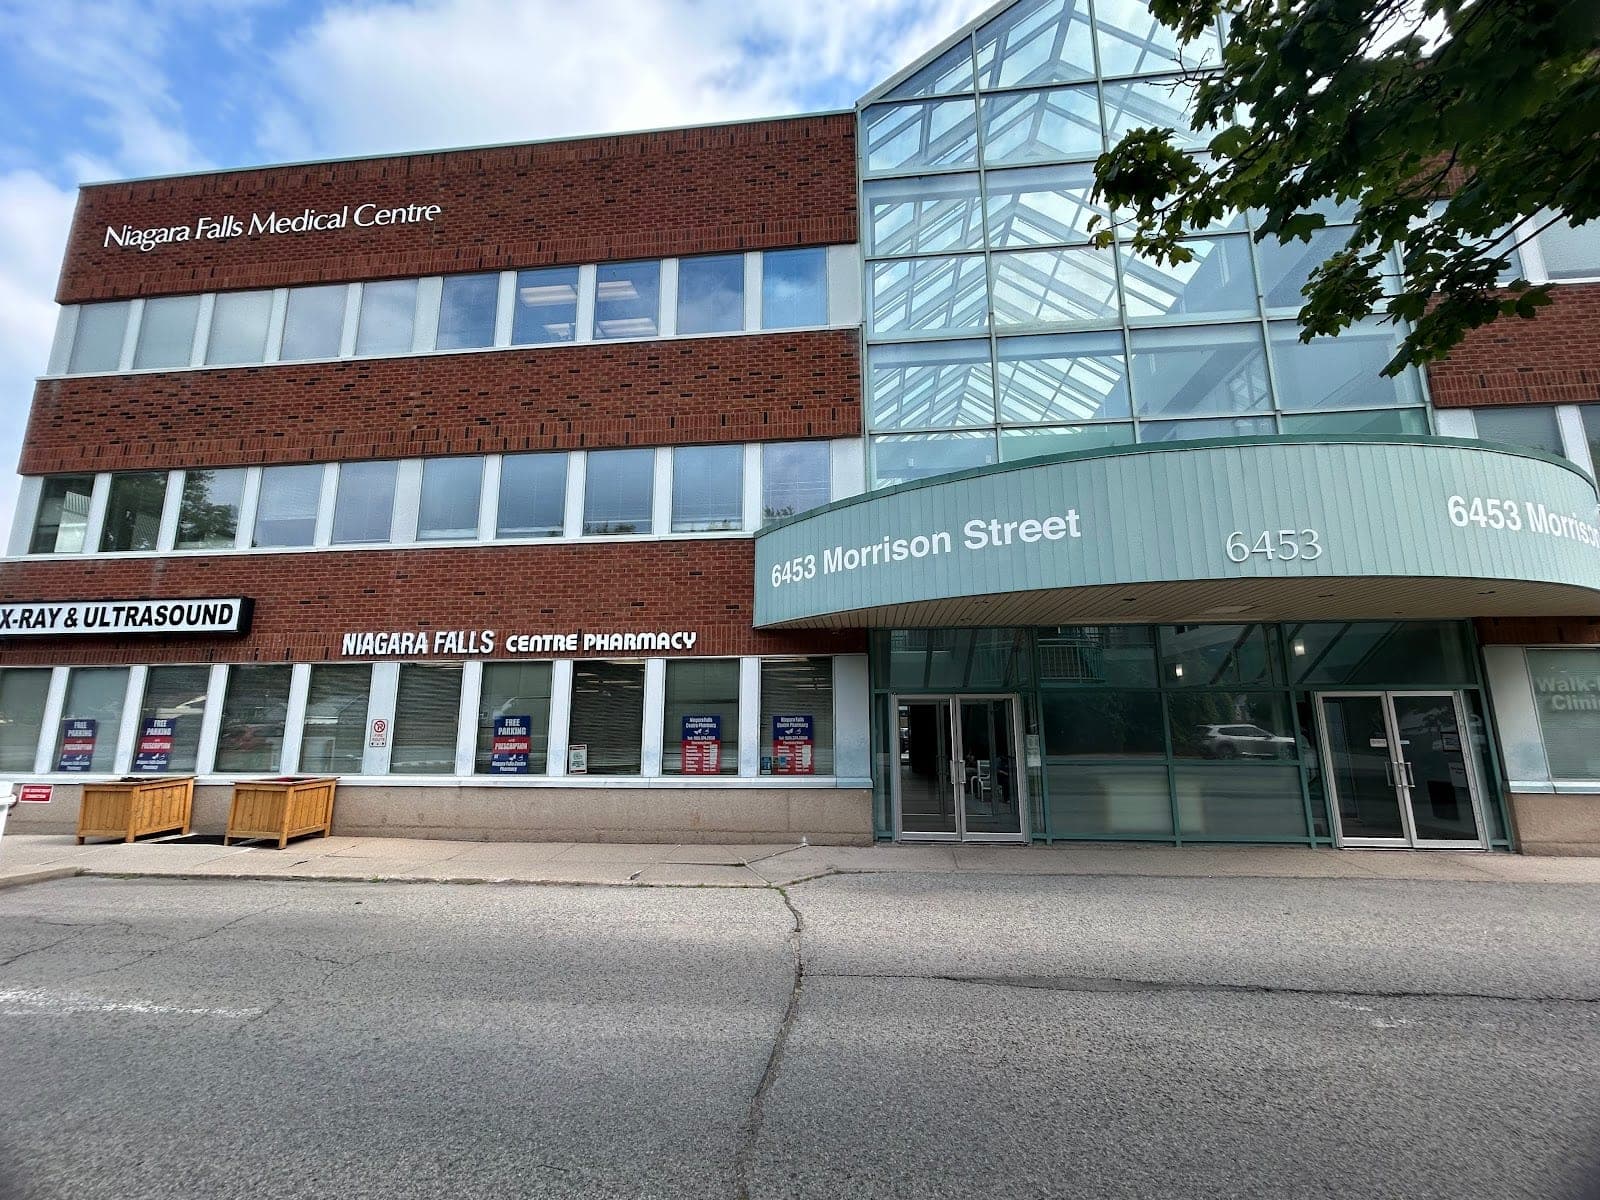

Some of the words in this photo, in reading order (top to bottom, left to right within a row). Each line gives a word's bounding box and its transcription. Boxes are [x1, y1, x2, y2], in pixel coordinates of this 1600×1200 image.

[104, 224, 190, 251] Niagara
[195, 215, 243, 240] Falls
[248, 206, 348, 235] Medical
[353, 203, 441, 227] Centre
[1447, 495, 1522, 531] 6453
[771, 554, 816, 588] 6453
[823, 530, 951, 575] Morrison
[963, 508, 1081, 550] Street
[1226, 529, 1322, 563] 6453
[0, 608, 62, 629] X-RAY
[64, 607, 78, 628] &
[83, 603, 233, 628] ULTRASOUND
[342, 632, 429, 655] NIAGARA
[433, 630, 495, 654] FALLS
[506, 634, 578, 652] CENTRE
[584, 632, 697, 650] PHARMACY
[1552, 694, 1600, 710] Clini
[146, 727, 172, 736] PARKING
[153, 719, 167, 727] FREE
[498, 727, 526, 736] PARKING
[505, 718, 520, 727] FREE
